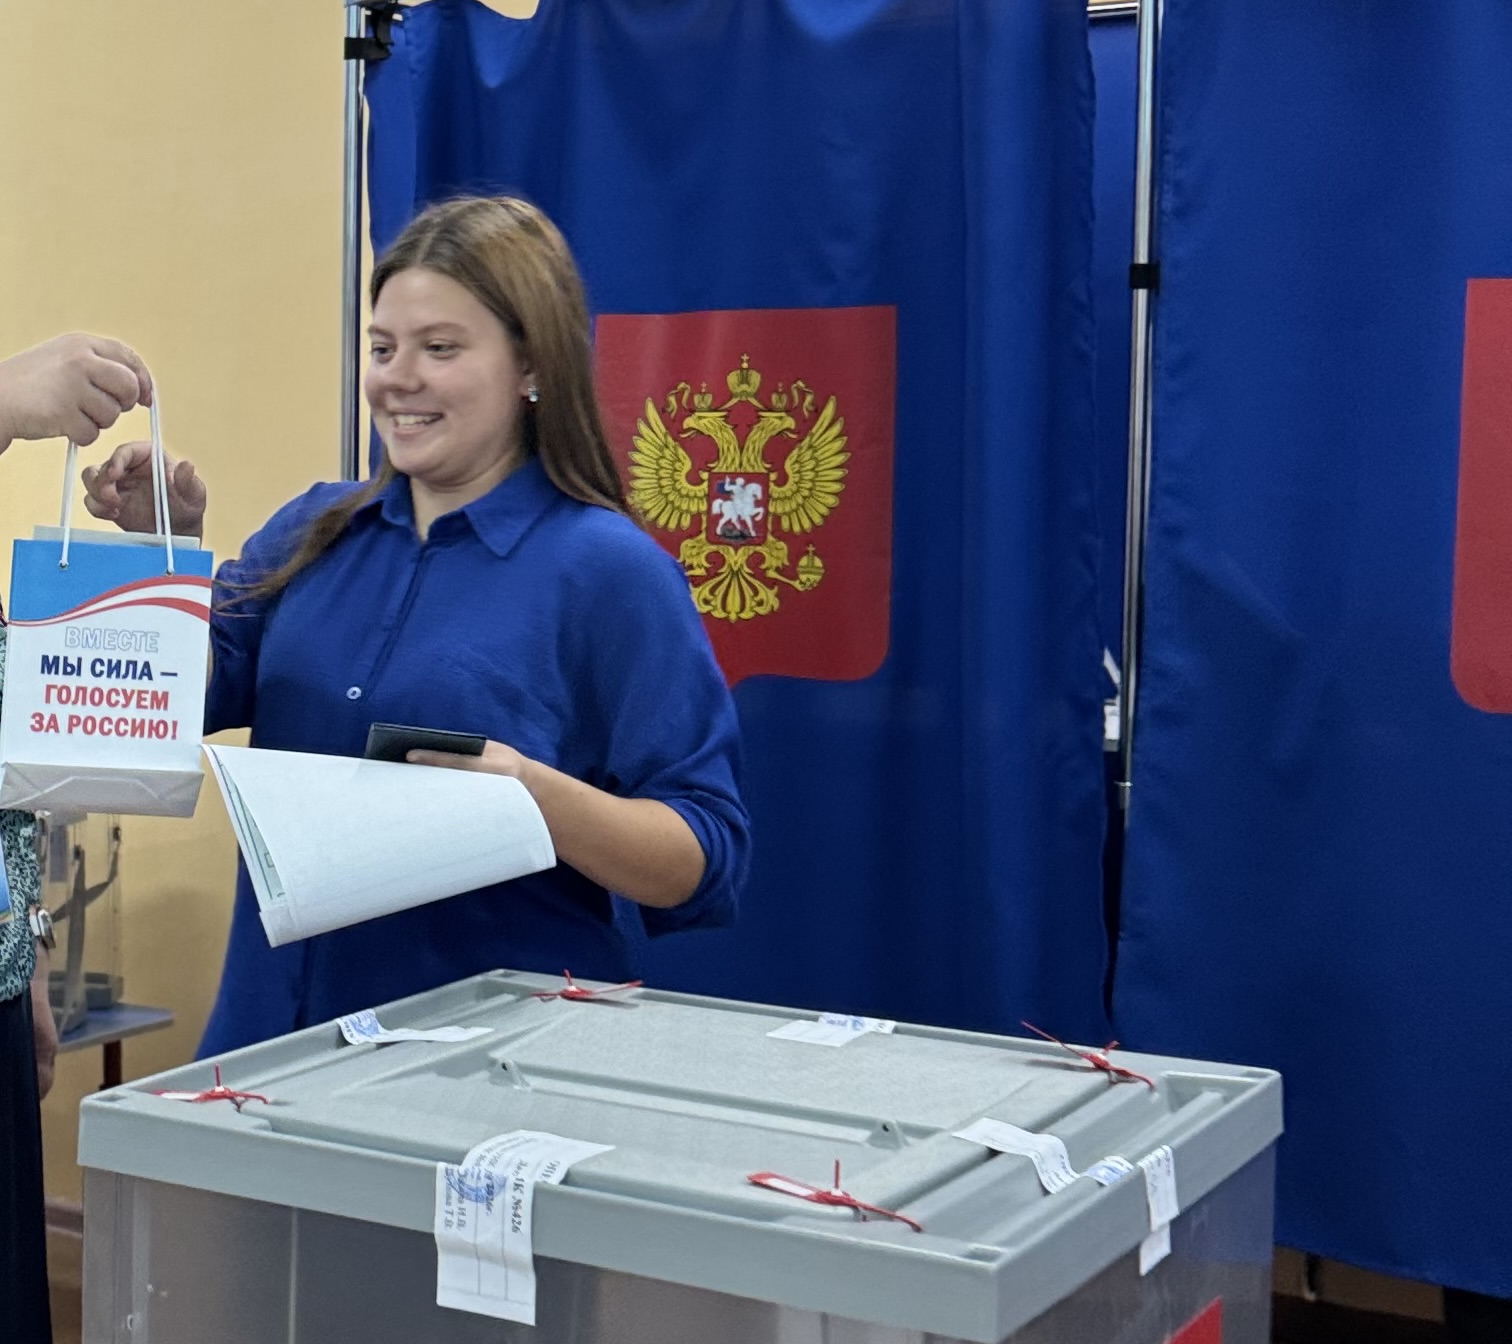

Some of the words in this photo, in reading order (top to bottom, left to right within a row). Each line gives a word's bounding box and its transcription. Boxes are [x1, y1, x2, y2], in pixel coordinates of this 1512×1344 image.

[64, 626, 159, 653] ВМЕСТЕ
[40, 655, 82, 676] МЫ
[90, 657, 153, 681] СИЛА
[44, 684, 169, 711] ГОЛОСУЕМ
[30, 712, 60, 733] ЗА
[67, 715, 178, 739] РОССИЮ!
